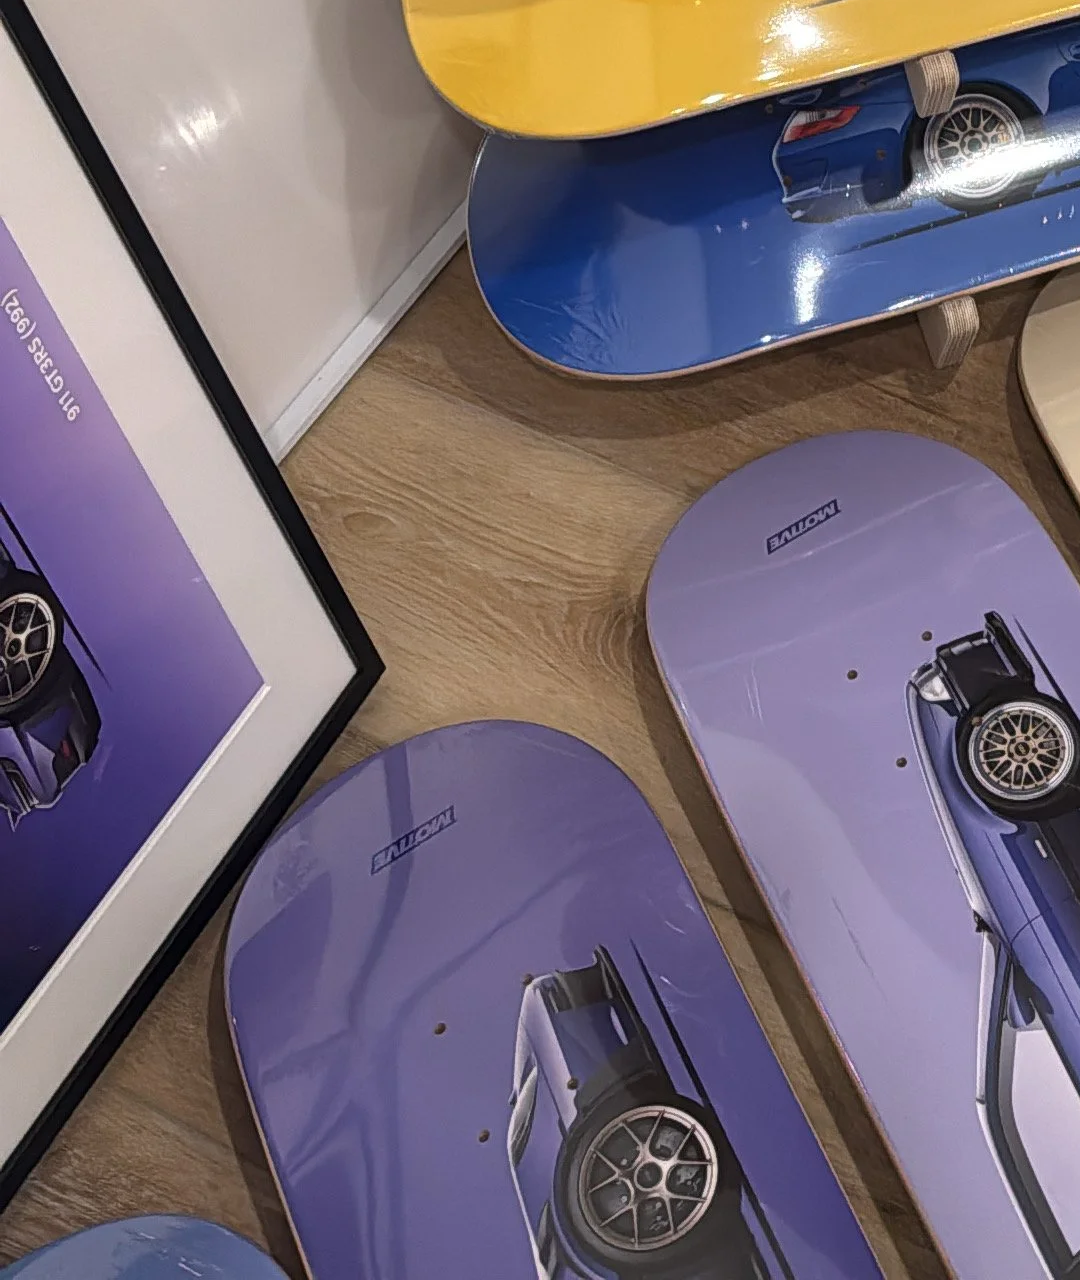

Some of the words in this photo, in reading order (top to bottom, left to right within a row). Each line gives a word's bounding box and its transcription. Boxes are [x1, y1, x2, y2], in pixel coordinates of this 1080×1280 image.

[0, 288, 37, 340] (992)
[27, 336, 64, 393] GT3RS
[59, 390, 80, 421] 911
[768, 501, 838, 552] MOTIVE
[373, 807, 454, 872] MOTIVE
